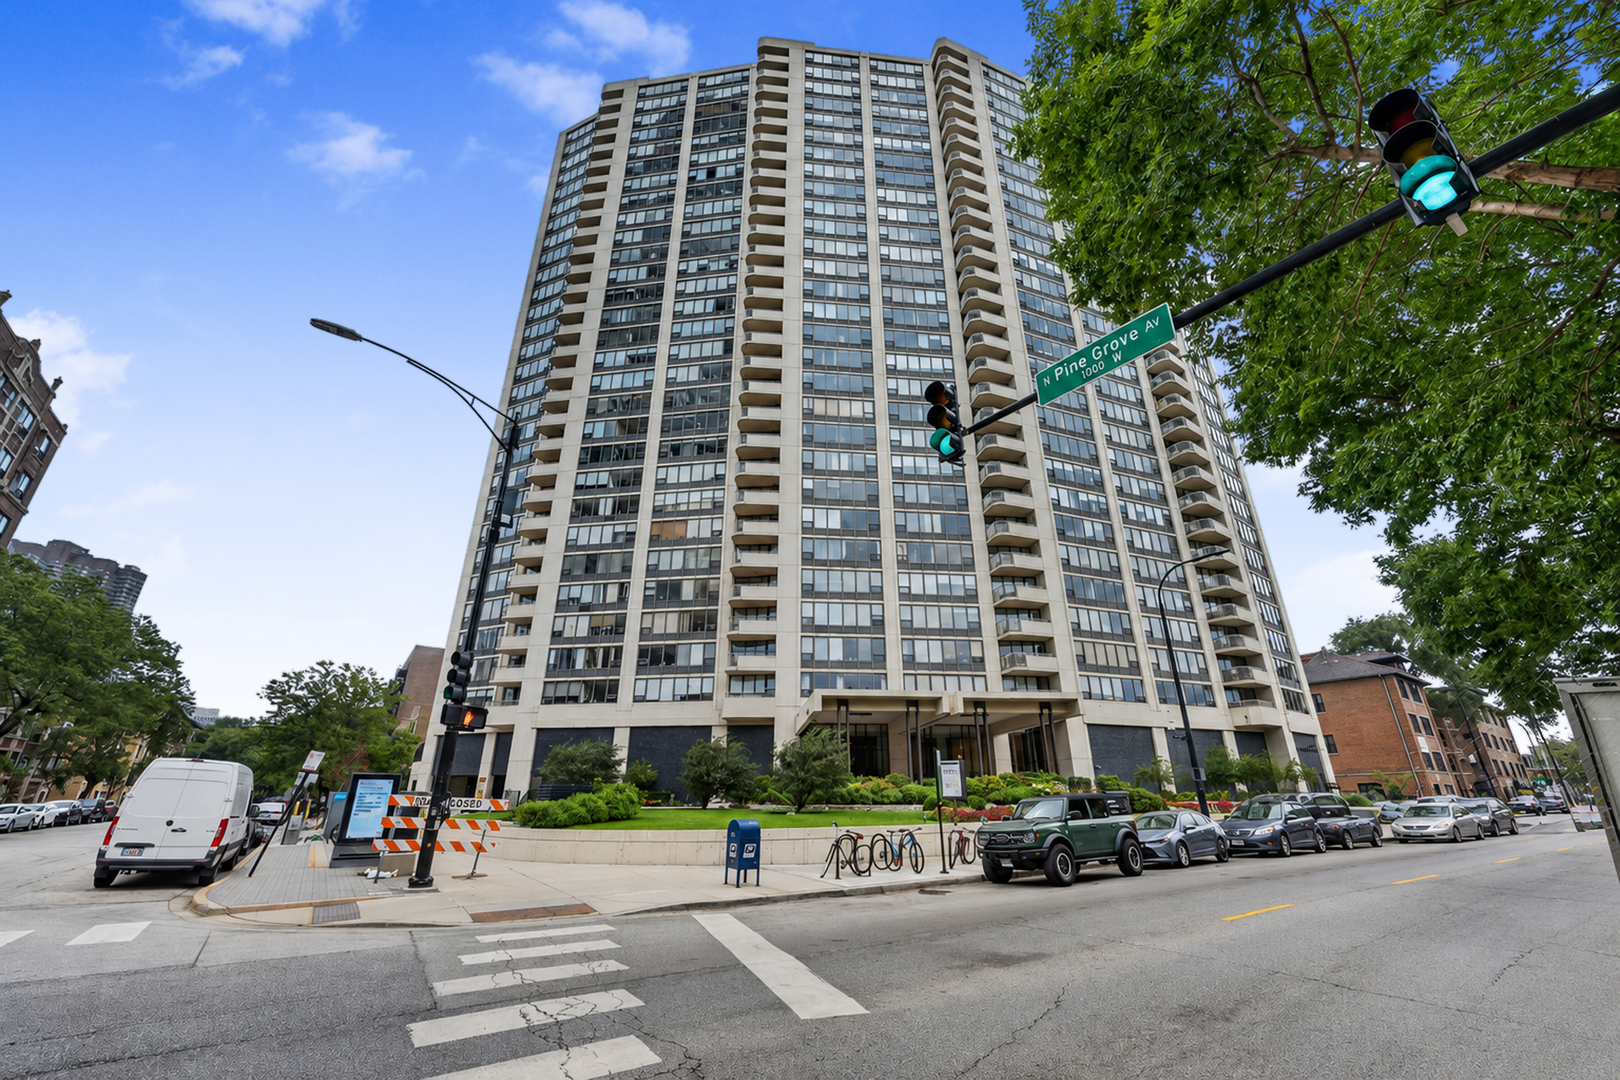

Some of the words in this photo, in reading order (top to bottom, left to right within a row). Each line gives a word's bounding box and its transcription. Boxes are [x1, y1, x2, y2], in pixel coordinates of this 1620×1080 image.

[1043, 375, 1051, 387] N
[1054, 357, 1087, 381] Pine
[1092, 329, 1139, 360] Grove
[1145, 316, 1160, 333] Av
[1081, 362, 1105, 380] 1000
[1112, 350, 1122, 363] W
